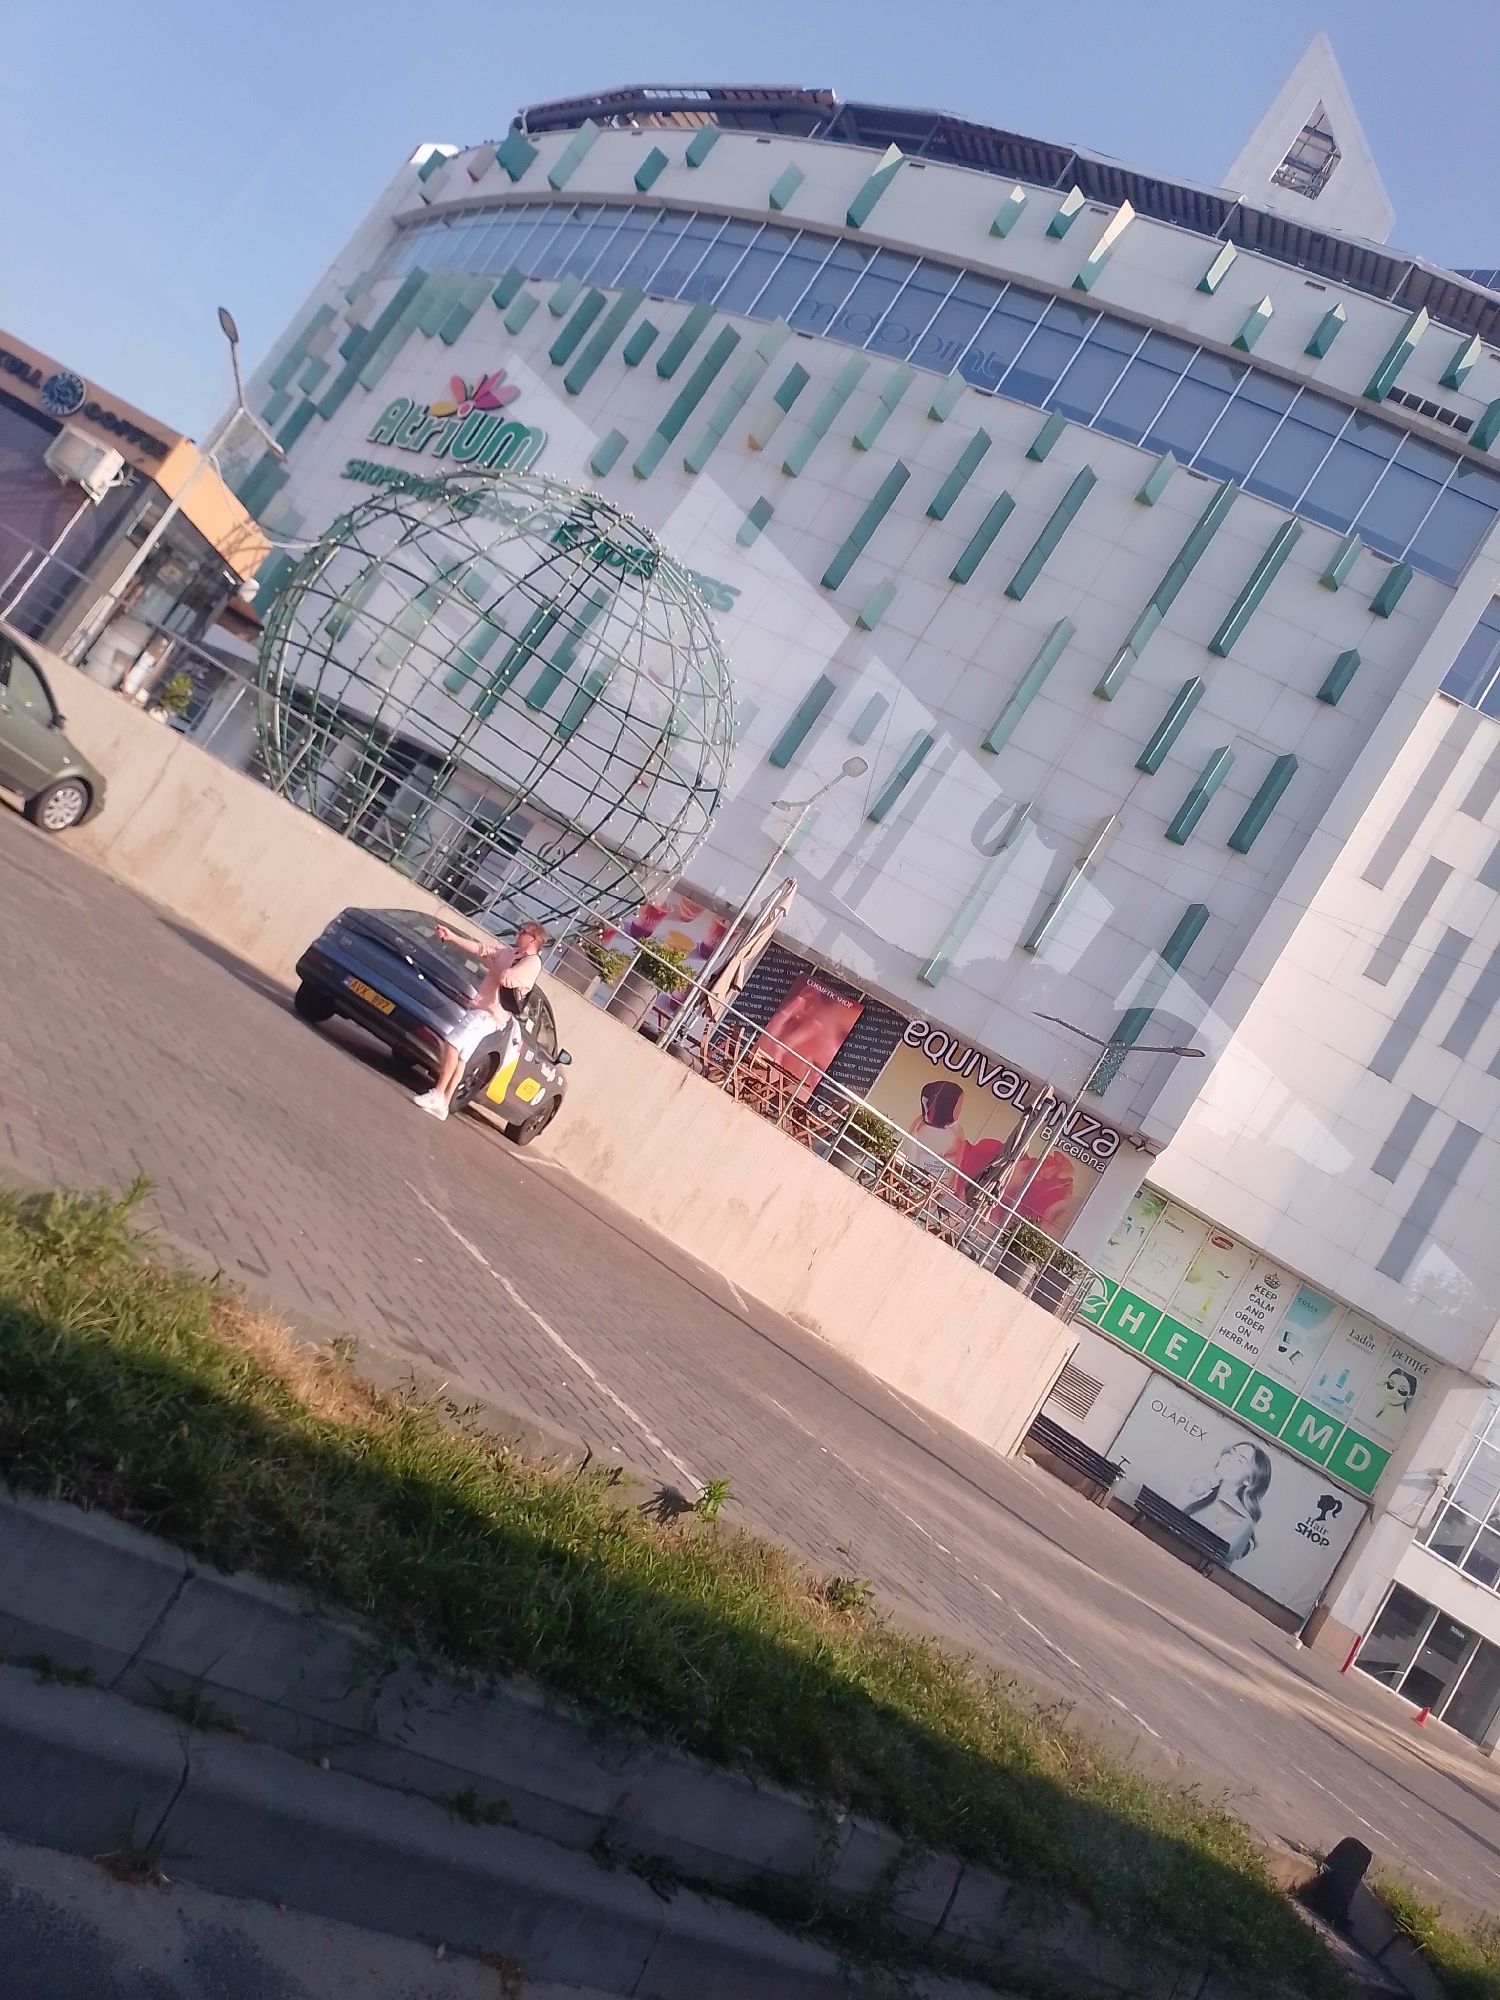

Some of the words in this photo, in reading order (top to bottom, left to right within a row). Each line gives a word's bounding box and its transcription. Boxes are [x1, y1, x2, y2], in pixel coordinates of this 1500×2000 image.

[806, 979, 836, 1000] COSMETIC
[837, 997, 854, 1009] SHOP
[1254, 1283, 1278, 1301] KEEP
[1245, 1305, 1265, 1319] AND
[1249, 1294, 1275, 1313] CALM
[1235, 1311, 1265, 1333] ORDER
[1237, 1325, 1252, 1338] ON
[1218, 1326, 1259, 1355] HERB.MD
[1150, 1399, 1208, 1442] OLAPLEX
[1295, 1521, 1330, 1548] SHOP
[1306, 1517, 1330, 1536] Hair
